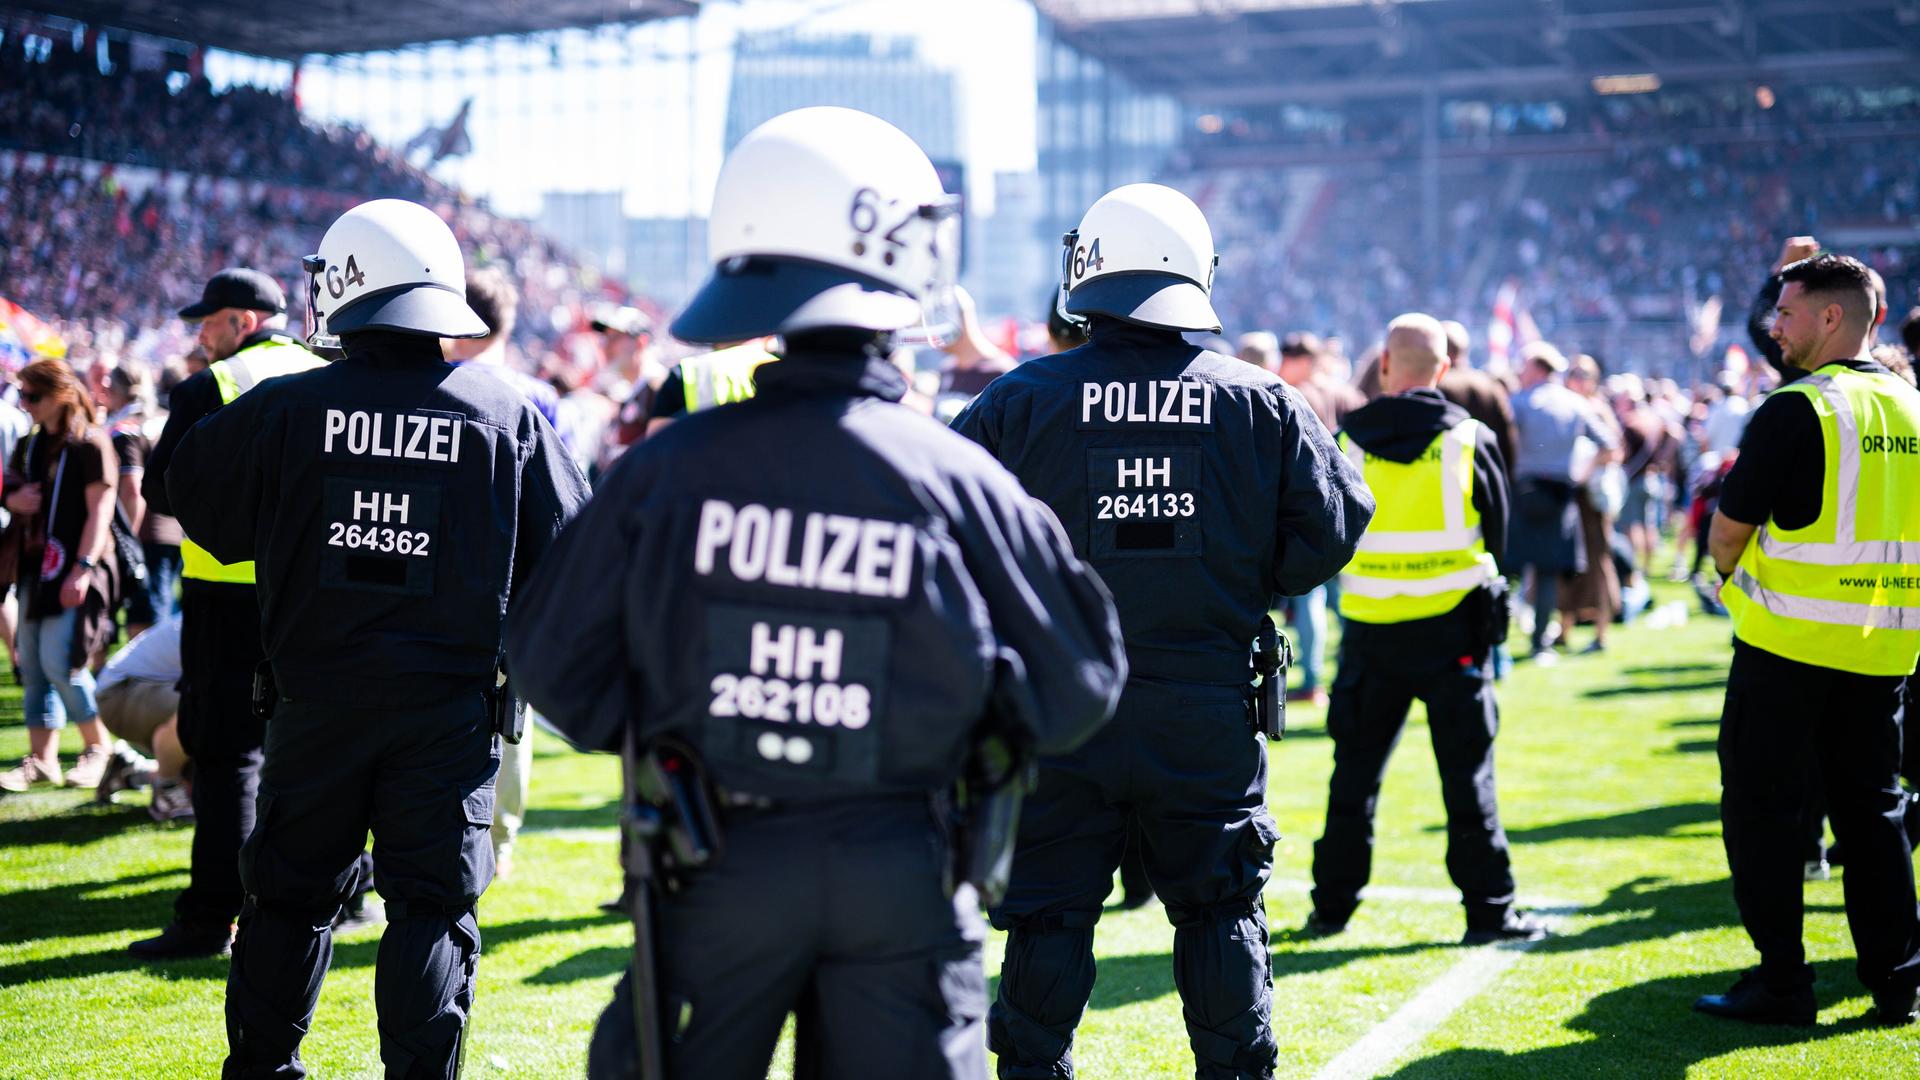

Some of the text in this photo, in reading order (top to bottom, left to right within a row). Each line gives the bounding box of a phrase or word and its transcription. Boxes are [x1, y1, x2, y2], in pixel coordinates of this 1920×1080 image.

[326, 254, 365, 299] 64
[1073, 237, 1104, 280] 64
[1082, 380, 1212, 424] POLIZEI
[324, 409, 461, 463] POLIZEI
[1862, 435, 1920, 455] ORDNE
[1117, 457, 1170, 488] HH
[353, 490, 410, 524] HH
[1097, 493, 1195, 519] 264133
[327, 522, 430, 556] 264362
[694, 499, 916, 599] POLIZEI
[750, 621, 844, 681] HH
[708, 673, 871, 729] 262108
